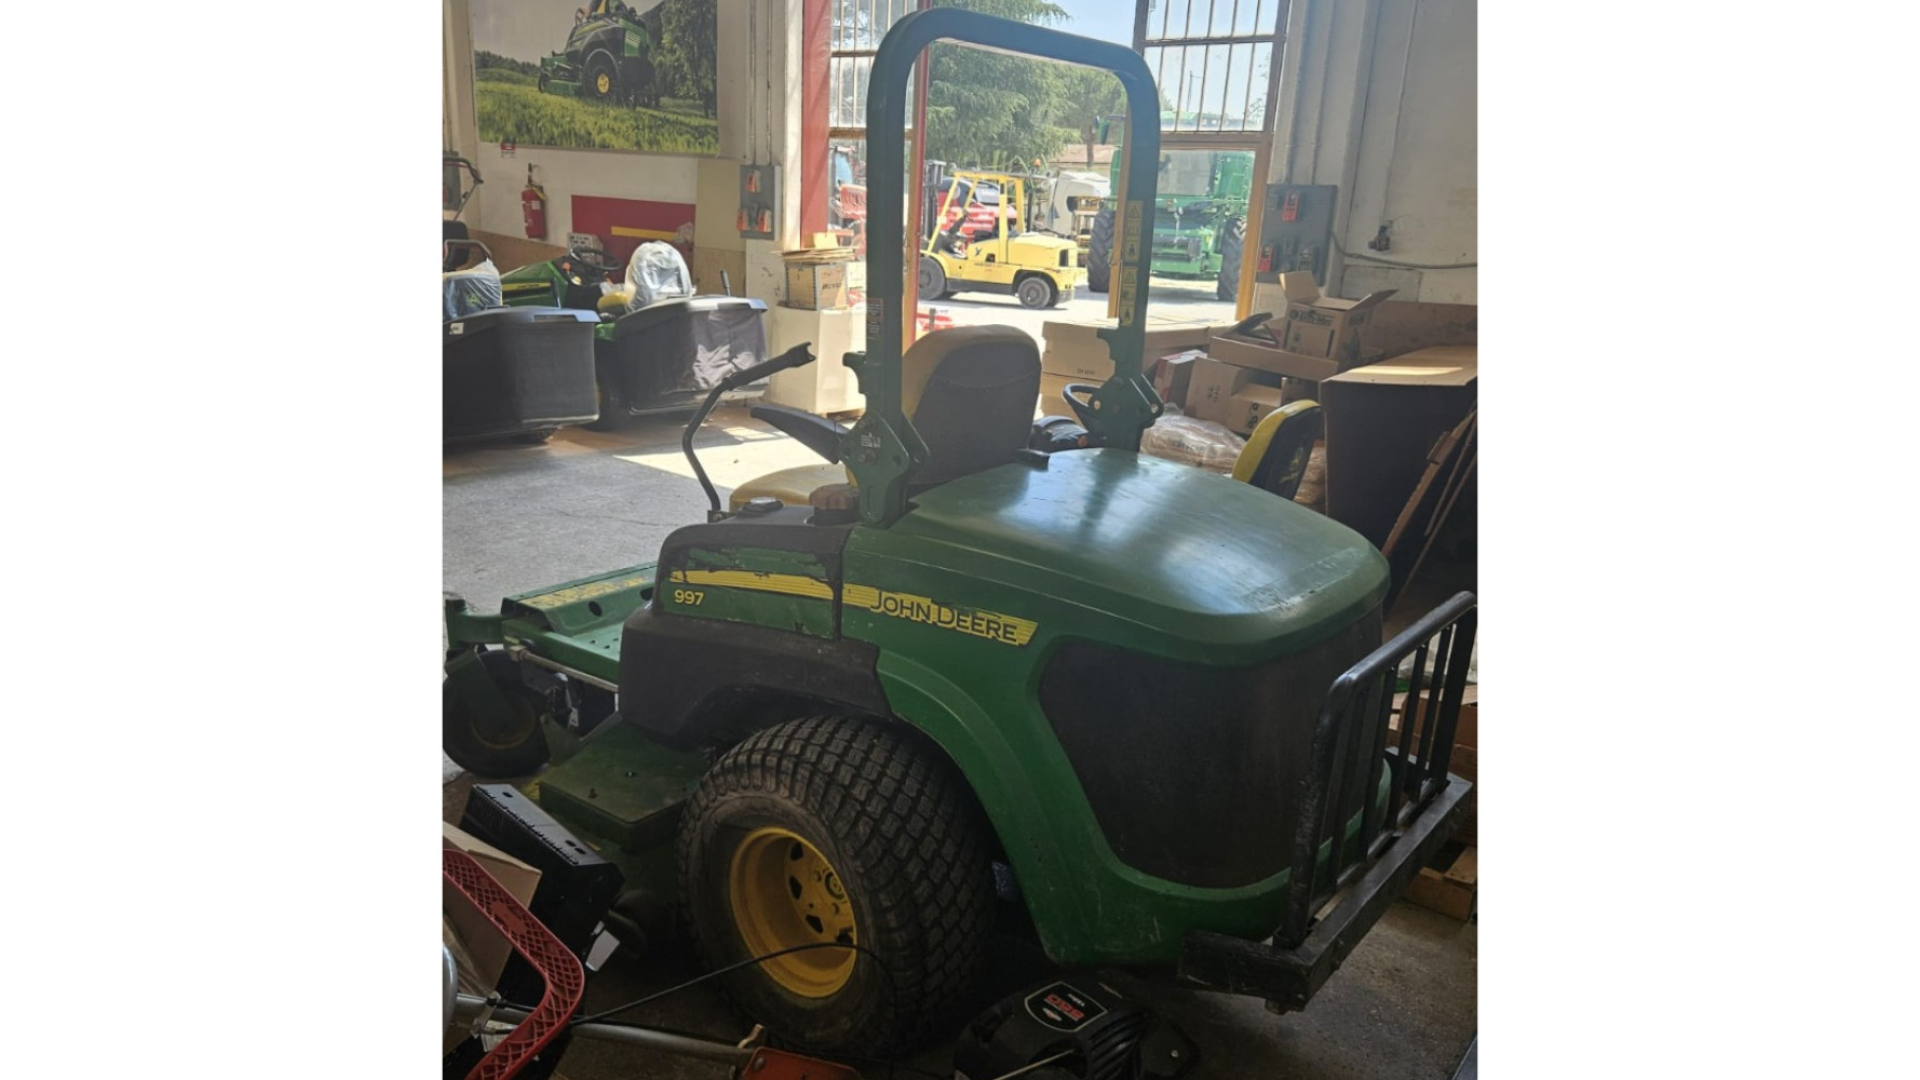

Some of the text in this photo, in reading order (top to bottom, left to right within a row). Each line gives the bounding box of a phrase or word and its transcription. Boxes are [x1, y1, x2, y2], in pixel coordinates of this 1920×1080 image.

[674, 589, 704, 606] 997
[870, 591, 1017, 642] JOHN DEERE
